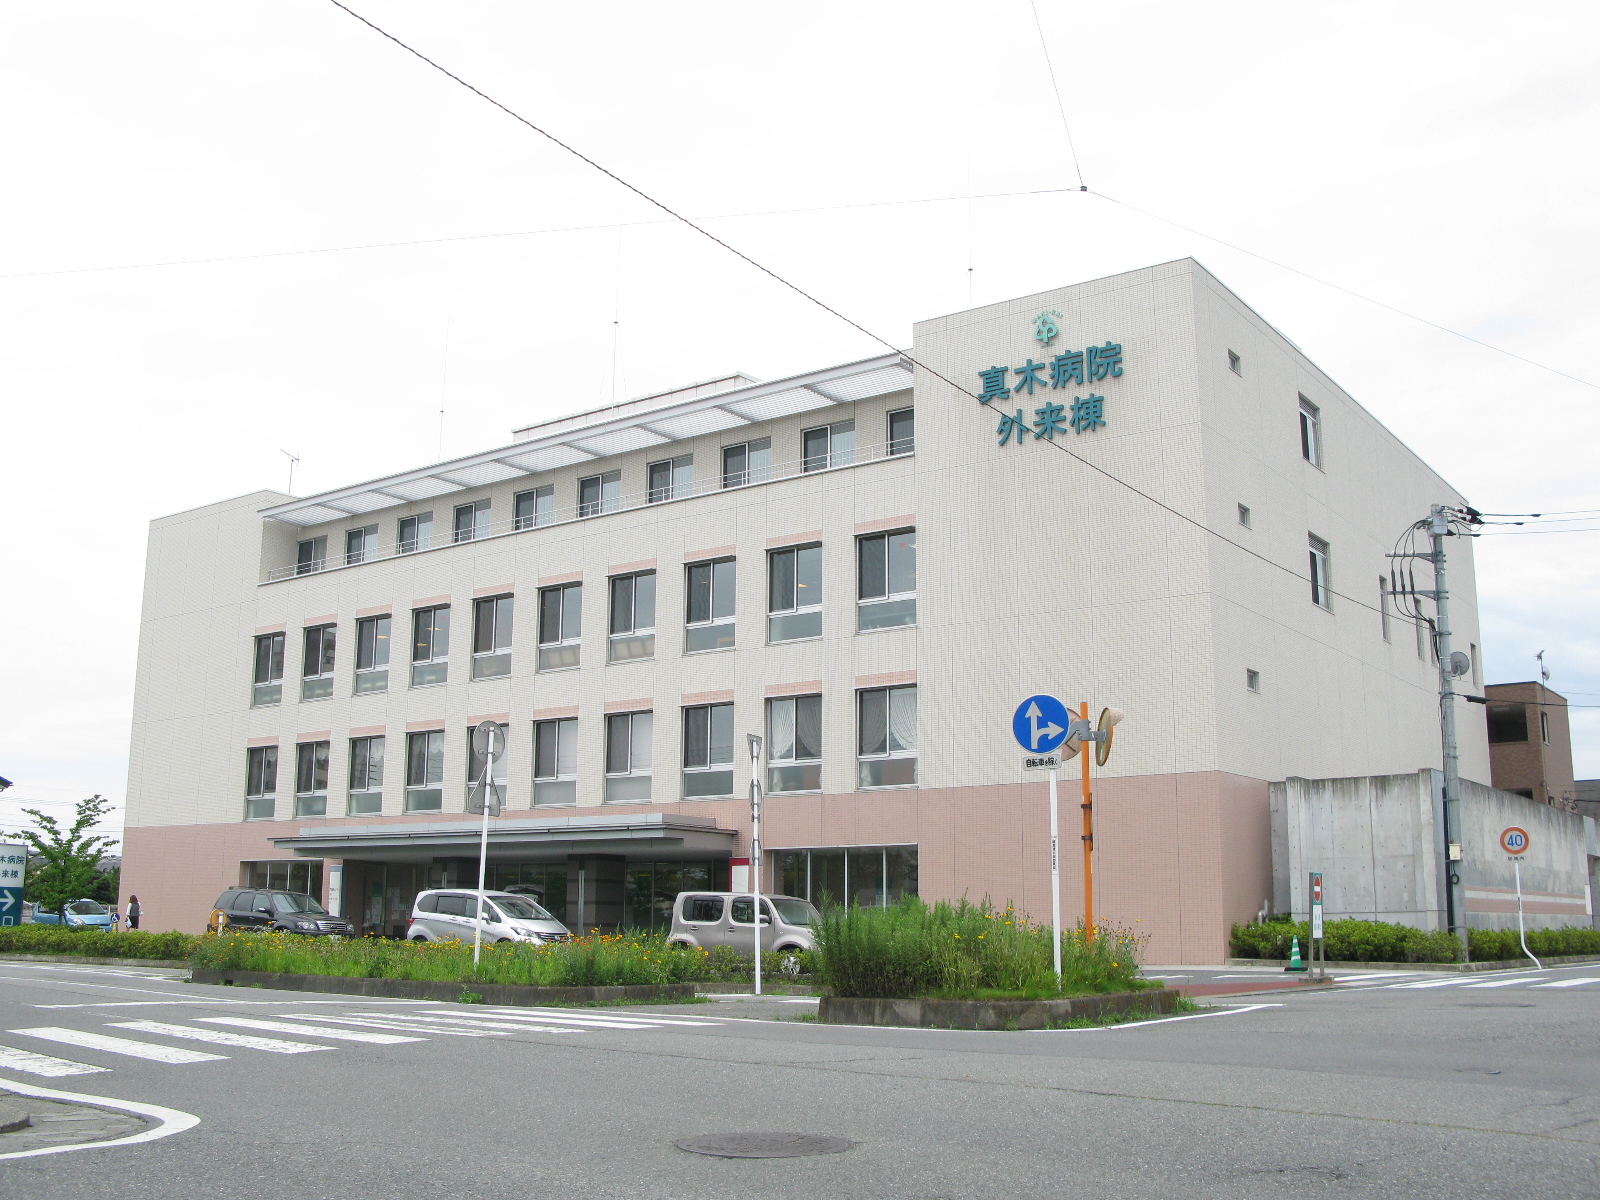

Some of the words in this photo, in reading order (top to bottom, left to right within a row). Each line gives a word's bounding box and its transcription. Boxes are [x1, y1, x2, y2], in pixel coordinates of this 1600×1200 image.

[978, 341, 1123, 405] 真木病院
[996, 393, 1107, 446] 外来棟
[1507, 834, 1523, 847] 40
[0, 869, 19, 878] 来棟
